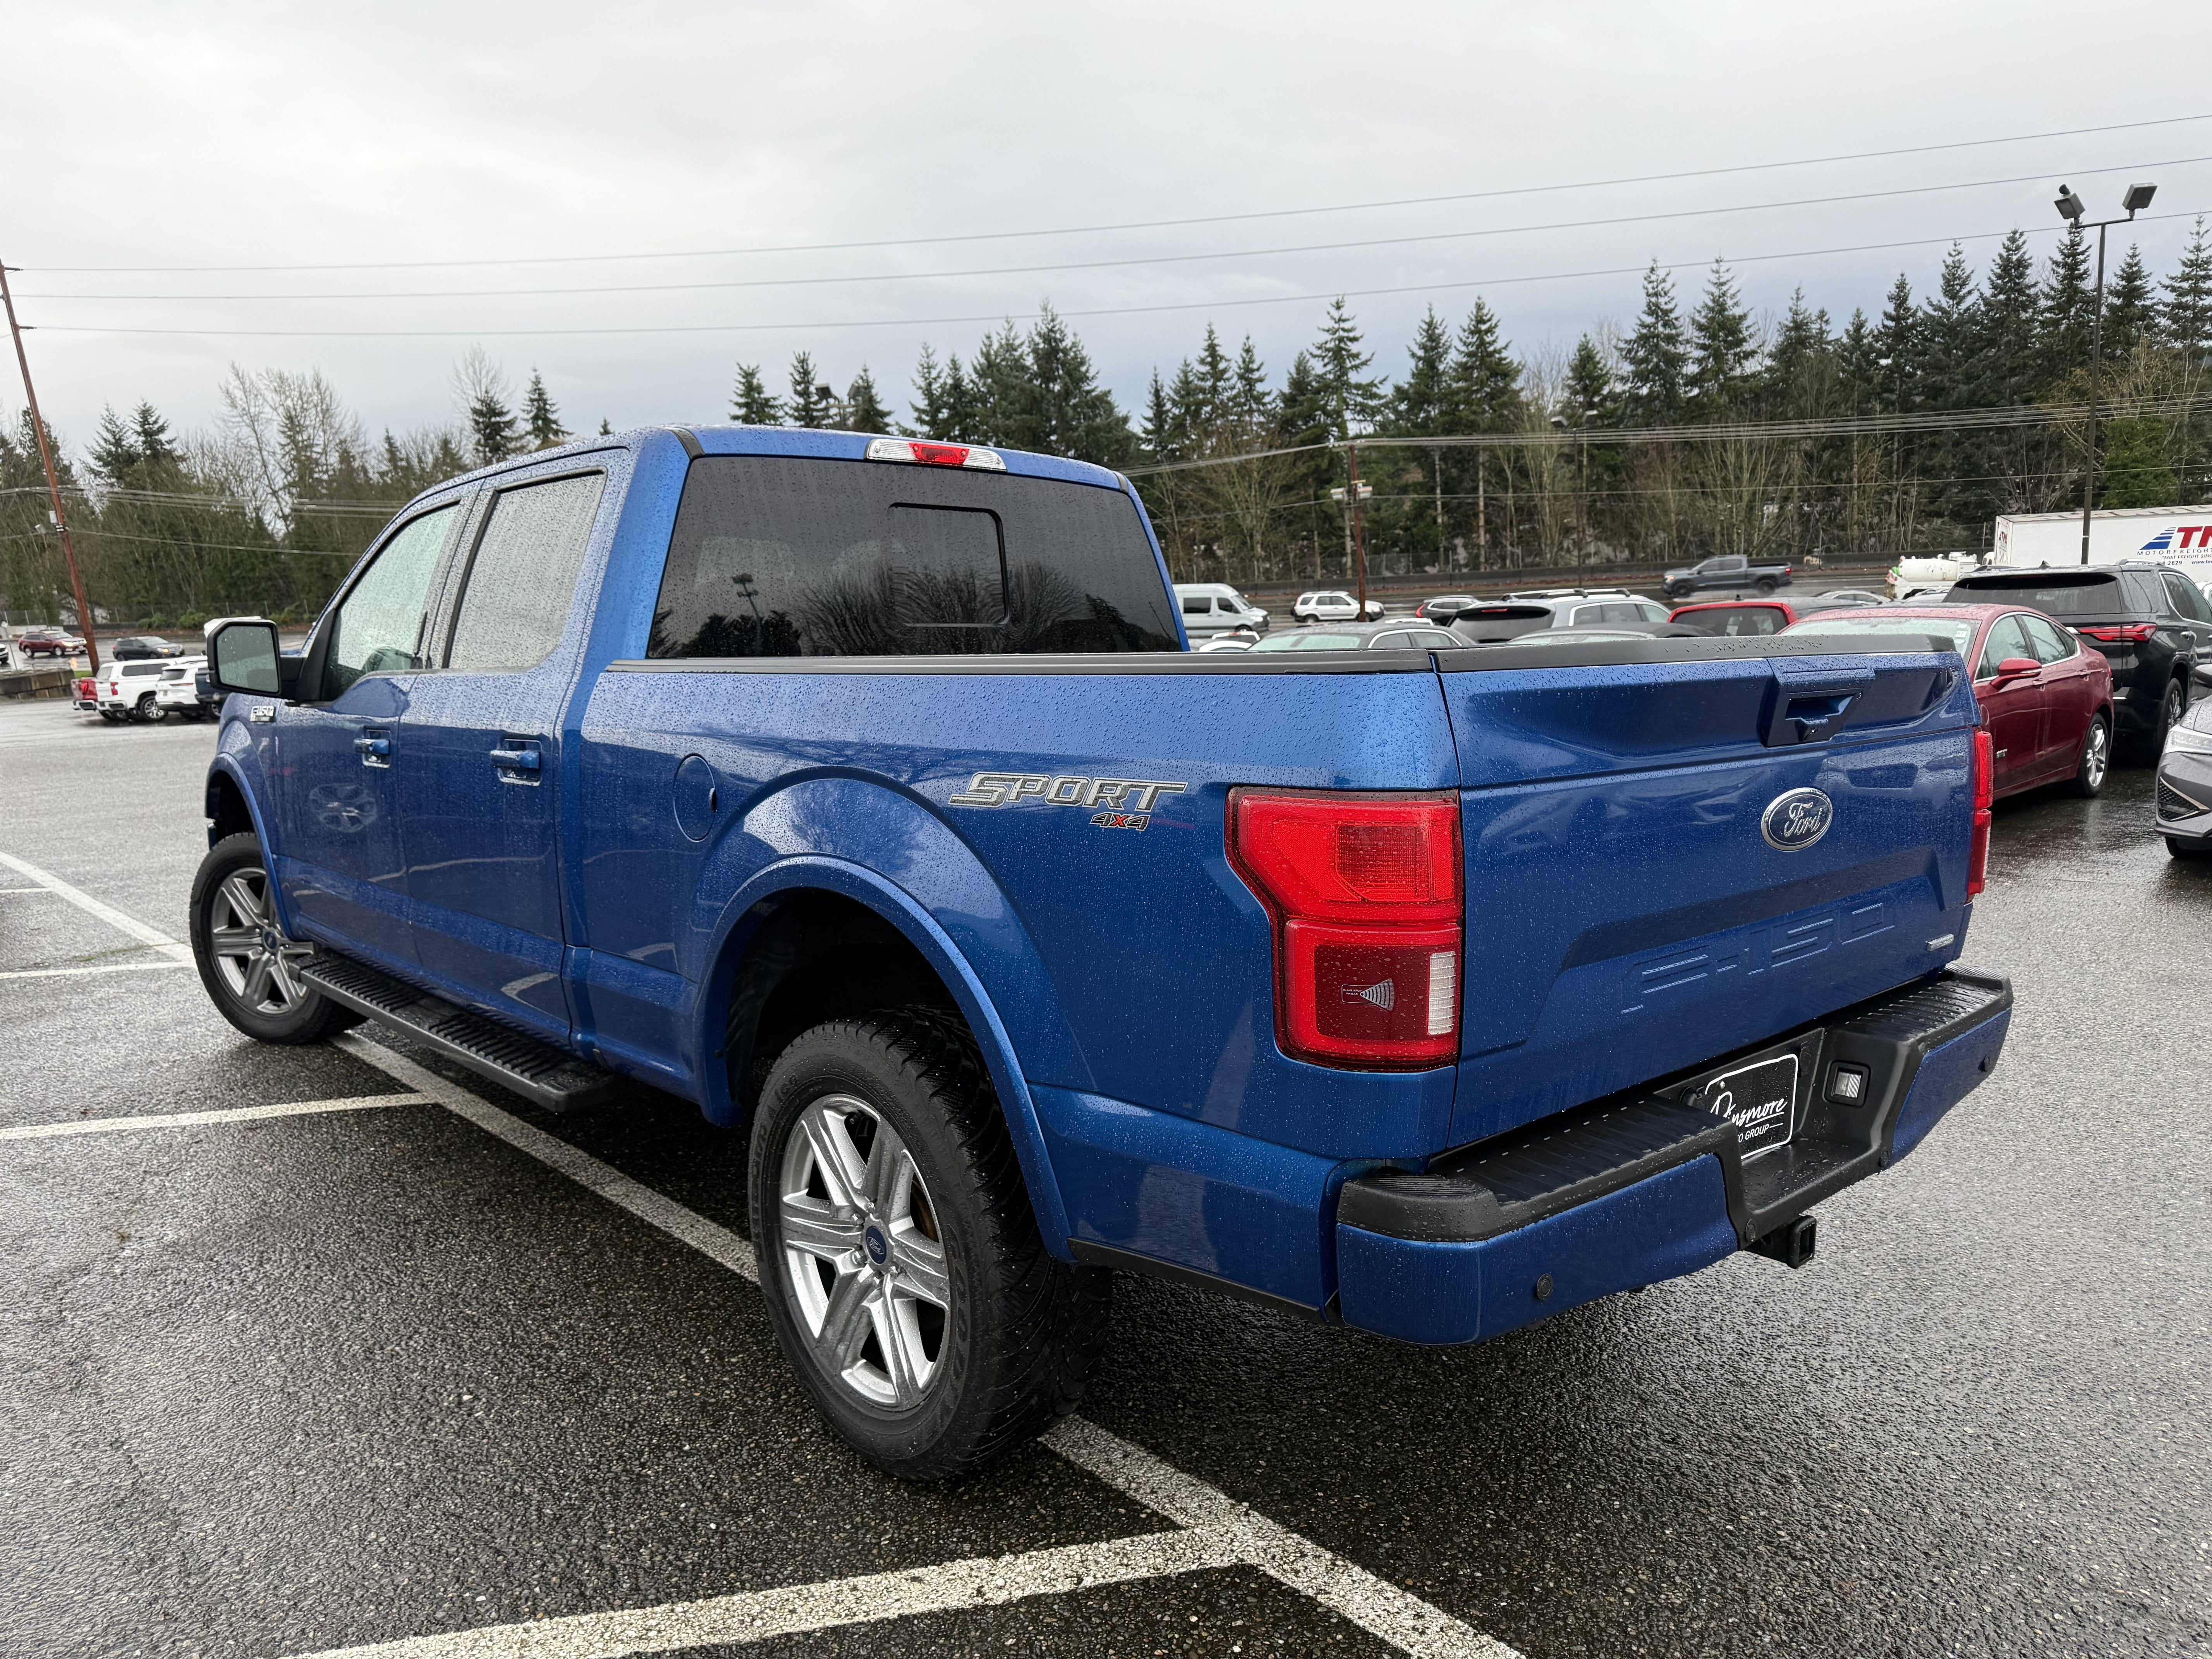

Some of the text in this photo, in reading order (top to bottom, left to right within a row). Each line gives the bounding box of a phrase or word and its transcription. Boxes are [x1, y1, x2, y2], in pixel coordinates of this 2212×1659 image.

[948, 771, 1188, 812] SPORT
[1784, 802, 1822, 837] Ford
[1745, 1124, 1769, 1140] GROUP
